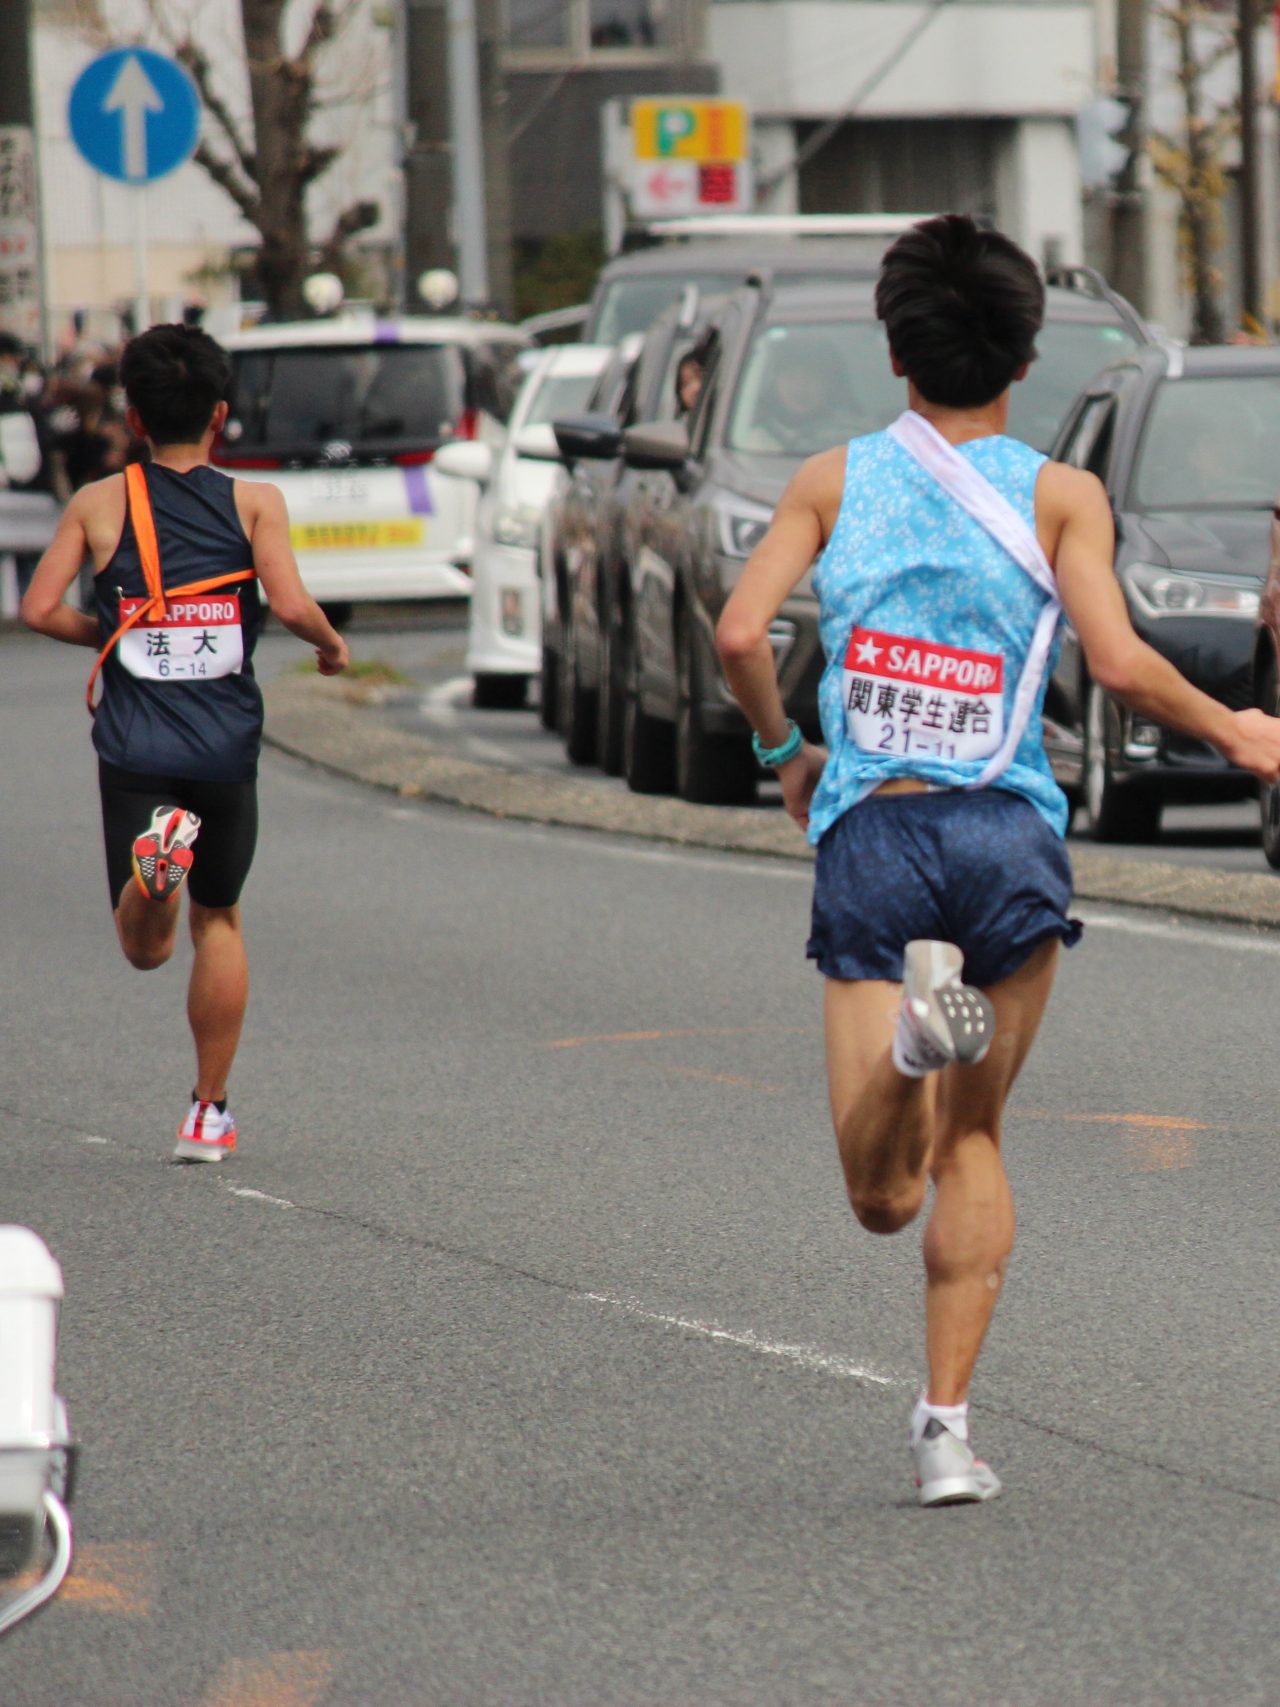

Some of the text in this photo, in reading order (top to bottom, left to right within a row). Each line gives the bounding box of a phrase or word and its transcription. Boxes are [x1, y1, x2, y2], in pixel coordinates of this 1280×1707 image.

[158, 658, 207, 677] 6-14
[847, 676, 992, 735] 関東学生連合
